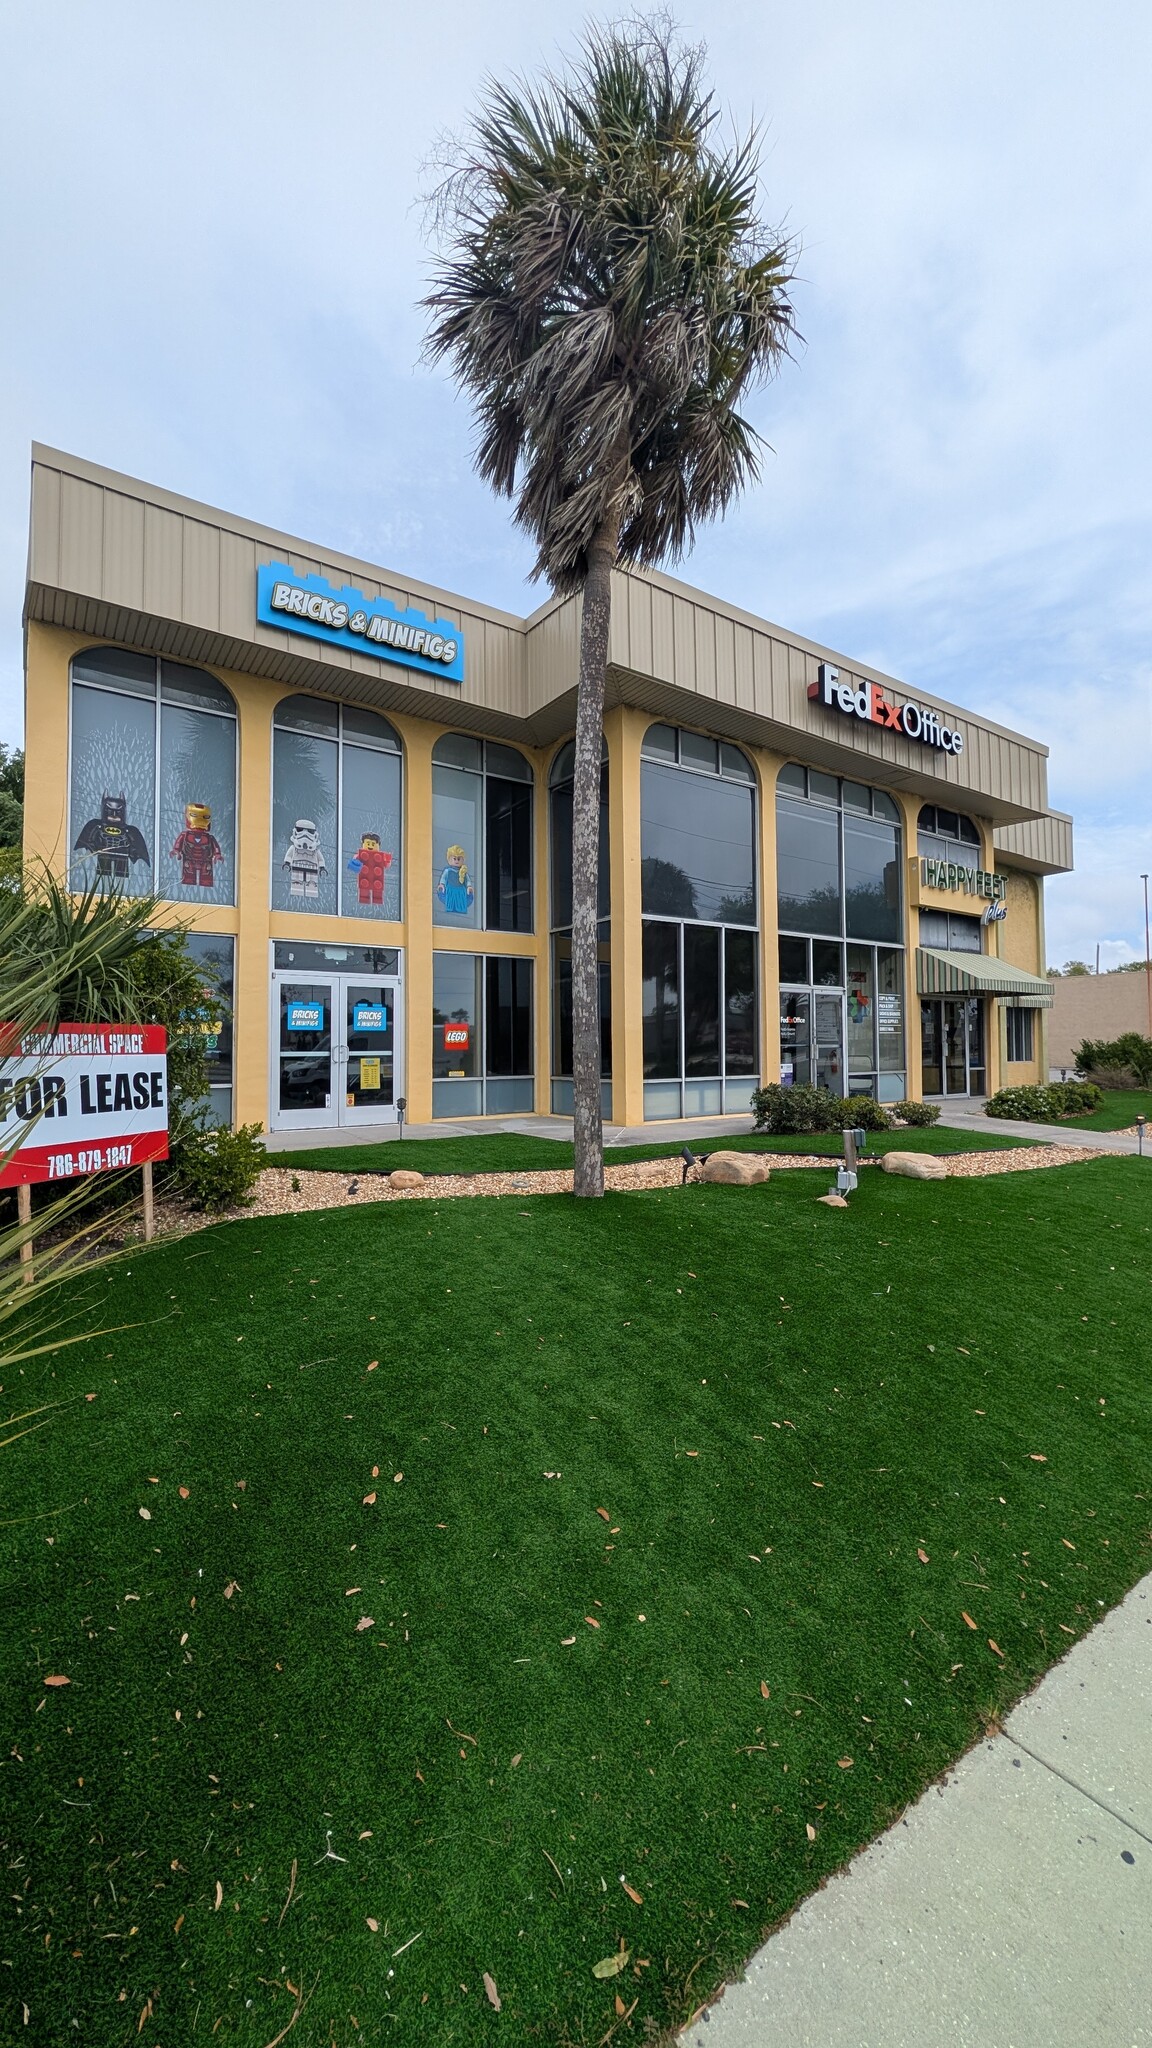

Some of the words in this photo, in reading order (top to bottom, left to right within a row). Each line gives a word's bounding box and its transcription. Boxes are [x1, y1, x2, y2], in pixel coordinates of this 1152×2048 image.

[273, 582, 349, 627] BRICKS
[350, 610, 367, 632] &
[367, 614, 457, 661] MINIFIGS
[824, 663, 903, 732] FedEx
[903, 702, 964, 755] Office
[923, 858, 974, 895] HAPPY
[975, 870, 1009, 901] FEET
[984, 899, 1008, 925] plus
[292, 1009, 319, 1019] BRICKS
[358, 1010, 382, 1020] BRICKS
[108, 1033, 144, 1054] SPACE
[446, 1031, 467, 1042] LEGO
[0, 1075, 68, 1122] FOR
[79, 1071, 164, 1115] LEASE
